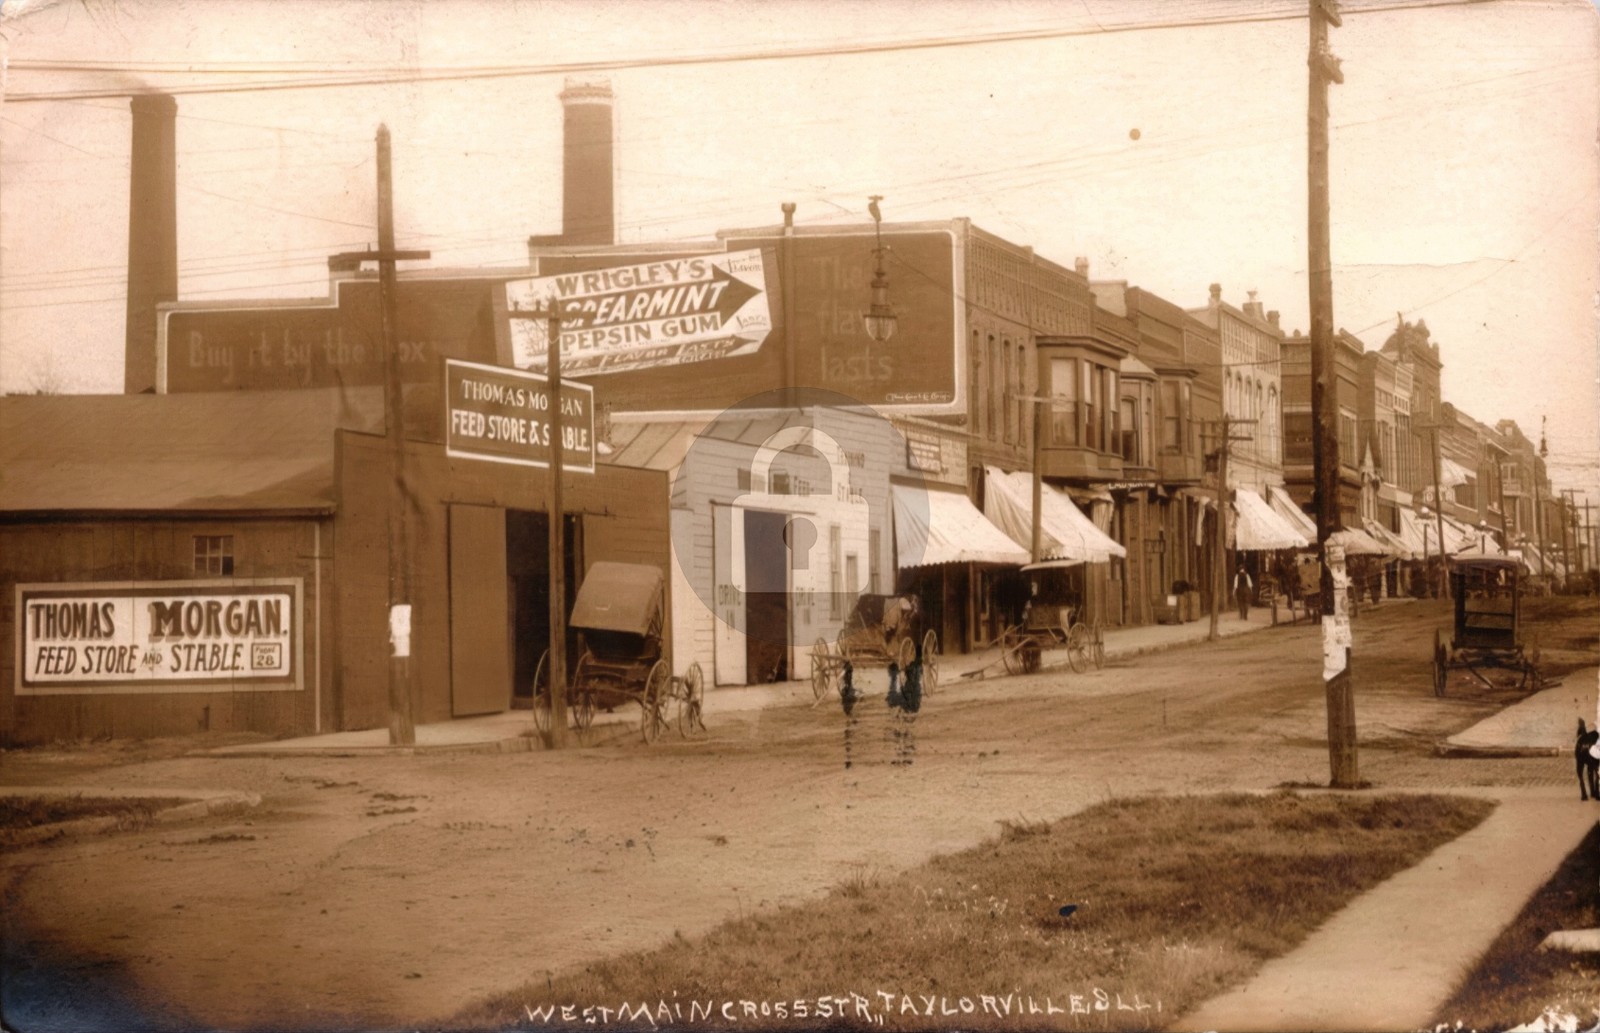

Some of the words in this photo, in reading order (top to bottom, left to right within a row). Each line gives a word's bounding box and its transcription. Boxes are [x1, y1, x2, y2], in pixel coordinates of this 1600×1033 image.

[555, 258, 706, 297] WRIGLEY'S
[563, 323, 652, 351] PEPSIN
[661, 314, 720, 338] GUM
[189, 329, 235, 385] Buy
[325, 327, 366, 365] the
[820, 345, 894, 381] lasts
[462, 379, 525, 407] THOMAS
[451, 409, 485, 439] FEED
[487, 415, 527, 444] STORE
[529, 420, 540, 445] &
[29, 602, 116, 640] THOMAS
[149, 599, 288, 641] MORGAN.
[35, 645, 77, 675] FEED
[81, 644, 139, 674] STORE
[141, 652, 163, 666] AND
[170, 643, 245, 673] STABLE.
[256, 655, 275, 666] 28
